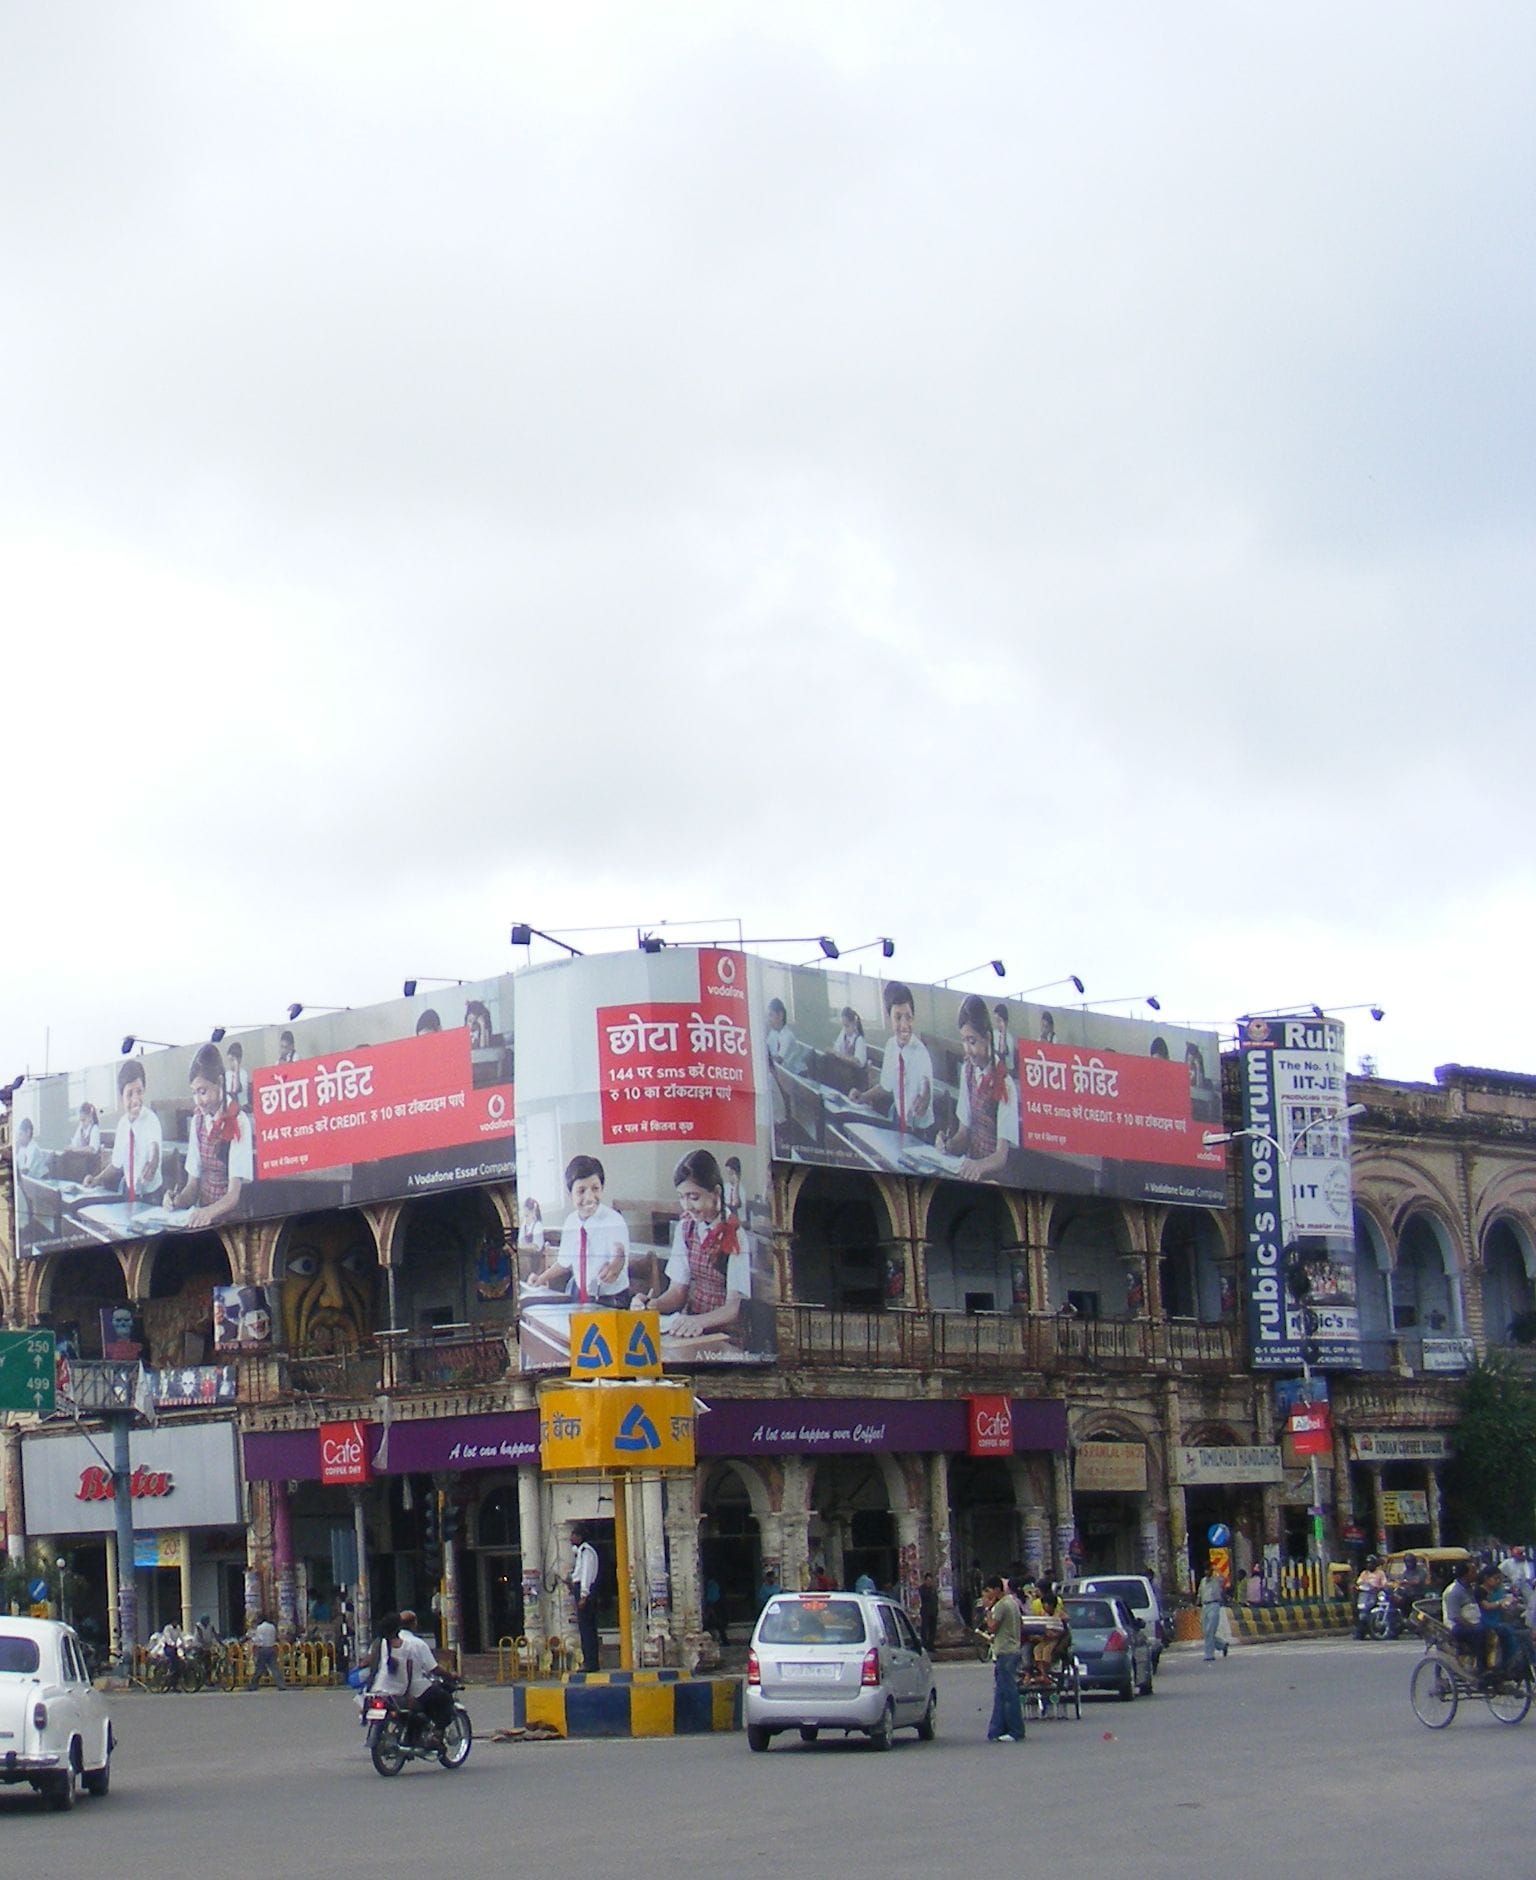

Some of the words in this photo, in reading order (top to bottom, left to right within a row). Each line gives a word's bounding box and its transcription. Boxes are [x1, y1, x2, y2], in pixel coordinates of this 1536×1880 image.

[707, 985, 745, 1000] vodafone
[606, 1012, 679, 1055] छोटा
[686, 1011, 748, 1056] क्रेडिट
[608, 1068, 634, 1082] 144
[637, 1066, 653, 1079] पर
[656, 1068, 686, 1079] sms
[687, 1062, 705, 1079] करें
[707, 1066, 743, 1082] CREDIT
[1024, 1049, 1067, 1091] छोटा
[1071, 1054, 1119, 1097] क्रेडिट
[1278, 1060, 1301, 1071] The
[1304, 1061, 1322, 1071] No.
[259, 1073, 310, 1115] छोटा
[314, 1060, 374, 1107] क्रेडिट
[623, 1087, 641, 1100] 10
[644, 1086, 660, 1099] का
[663, 1083, 713, 1100] टॉकटाइम
[261, 1127, 280, 1142] 144
[280, 1125, 292, 1139] पर
[293, 1123, 315, 1137] sms
[380, 1105, 393, 1121] 10
[479, 1118, 515, 1132] vodafone
[1247, 1050, 1274, 1199] rostrum
[407, 1175, 414, 1187] A
[414, 1170, 454, 1186] Vodafone
[454, 1167, 478, 1180] Essar
[479, 1161, 515, 1177] Company
[1250, 1211, 1281, 1341] rubic's
[27, 1340, 50, 1353] 250
[26, 1377, 50, 1391] 499
[553, 1411, 582, 1440] बैंक
[752, 1425, 764, 1442] A
[765, 1426, 778, 1441] lot
[780, 1430, 796, 1441] can
[799, 1426, 831, 1444] happen
[832, 1430, 851, 1440] over
[448, 1443, 461, 1460] A
[463, 1442, 478, 1458] lot
[479, 1446, 497, 1457] can
[500, 1440, 535, 1459] happen
